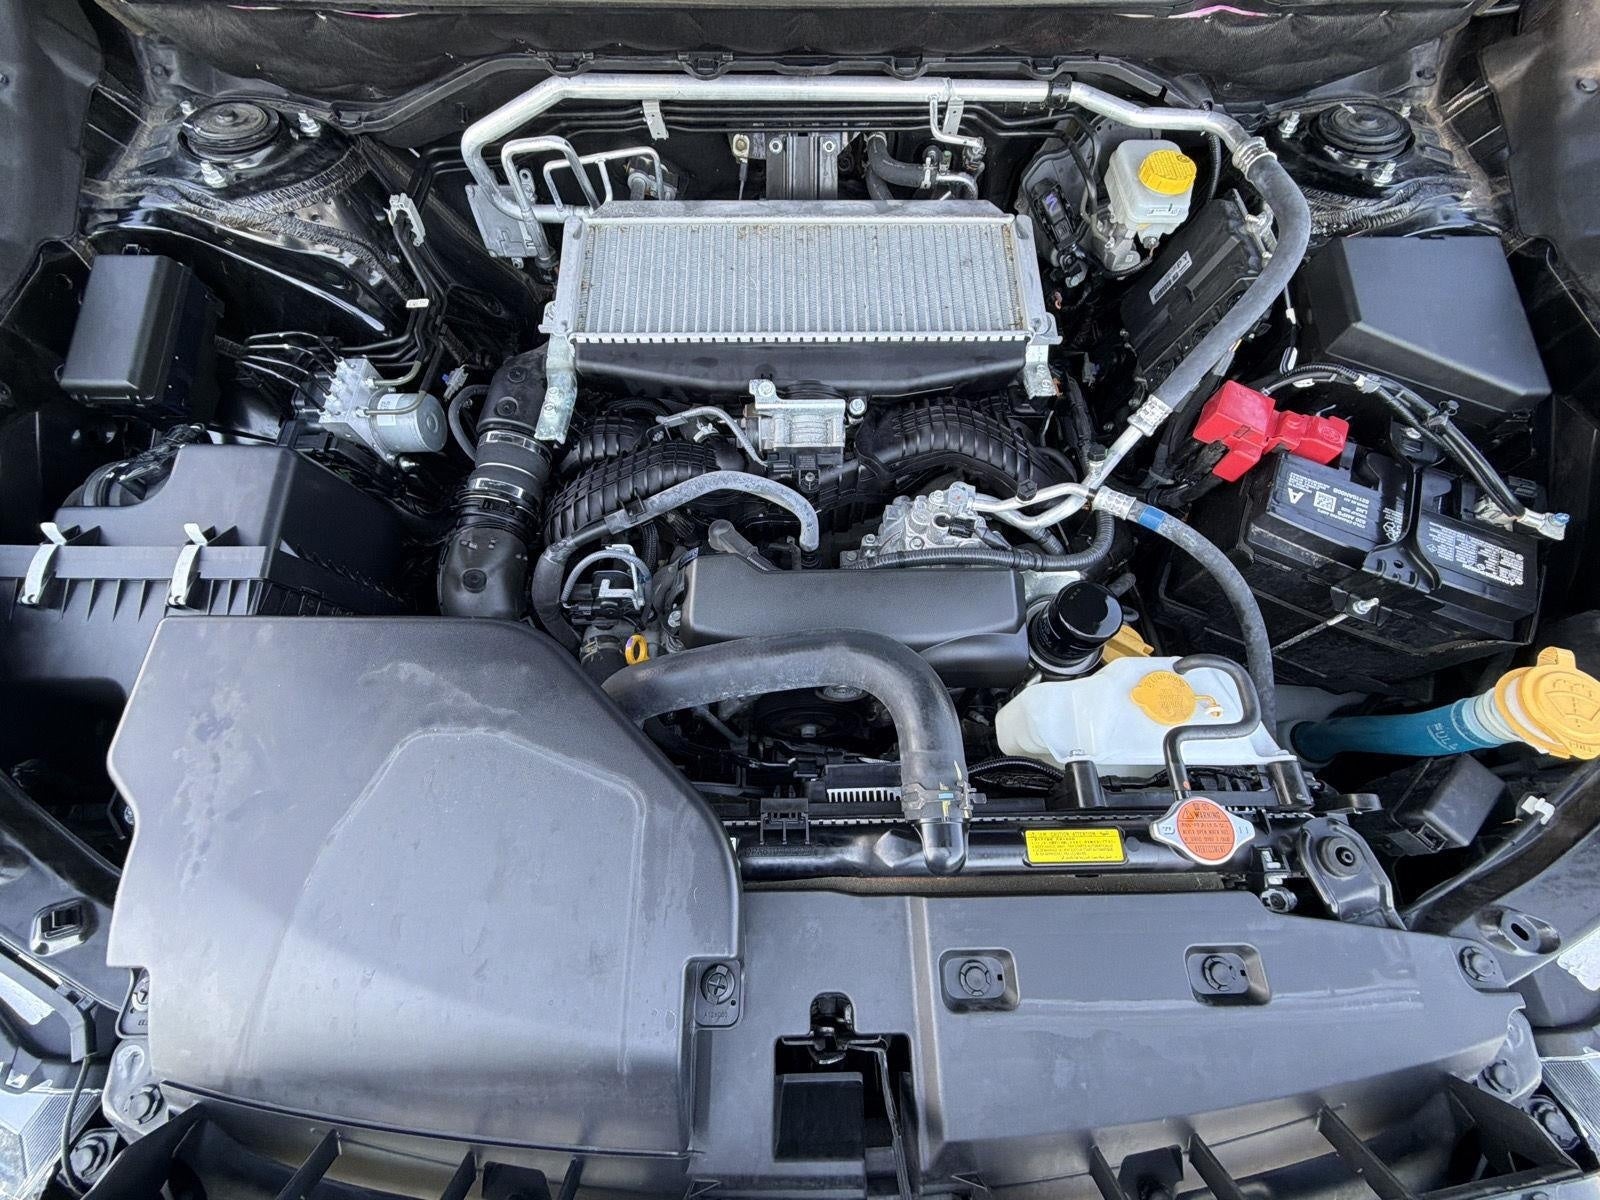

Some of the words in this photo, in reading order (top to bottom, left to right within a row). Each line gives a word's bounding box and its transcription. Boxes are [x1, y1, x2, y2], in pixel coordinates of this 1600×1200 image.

[1288, 488, 1304, 504] A
[1352, 521, 1366, 529] COLD
[1193, 811, 1221, 820] WARNING
